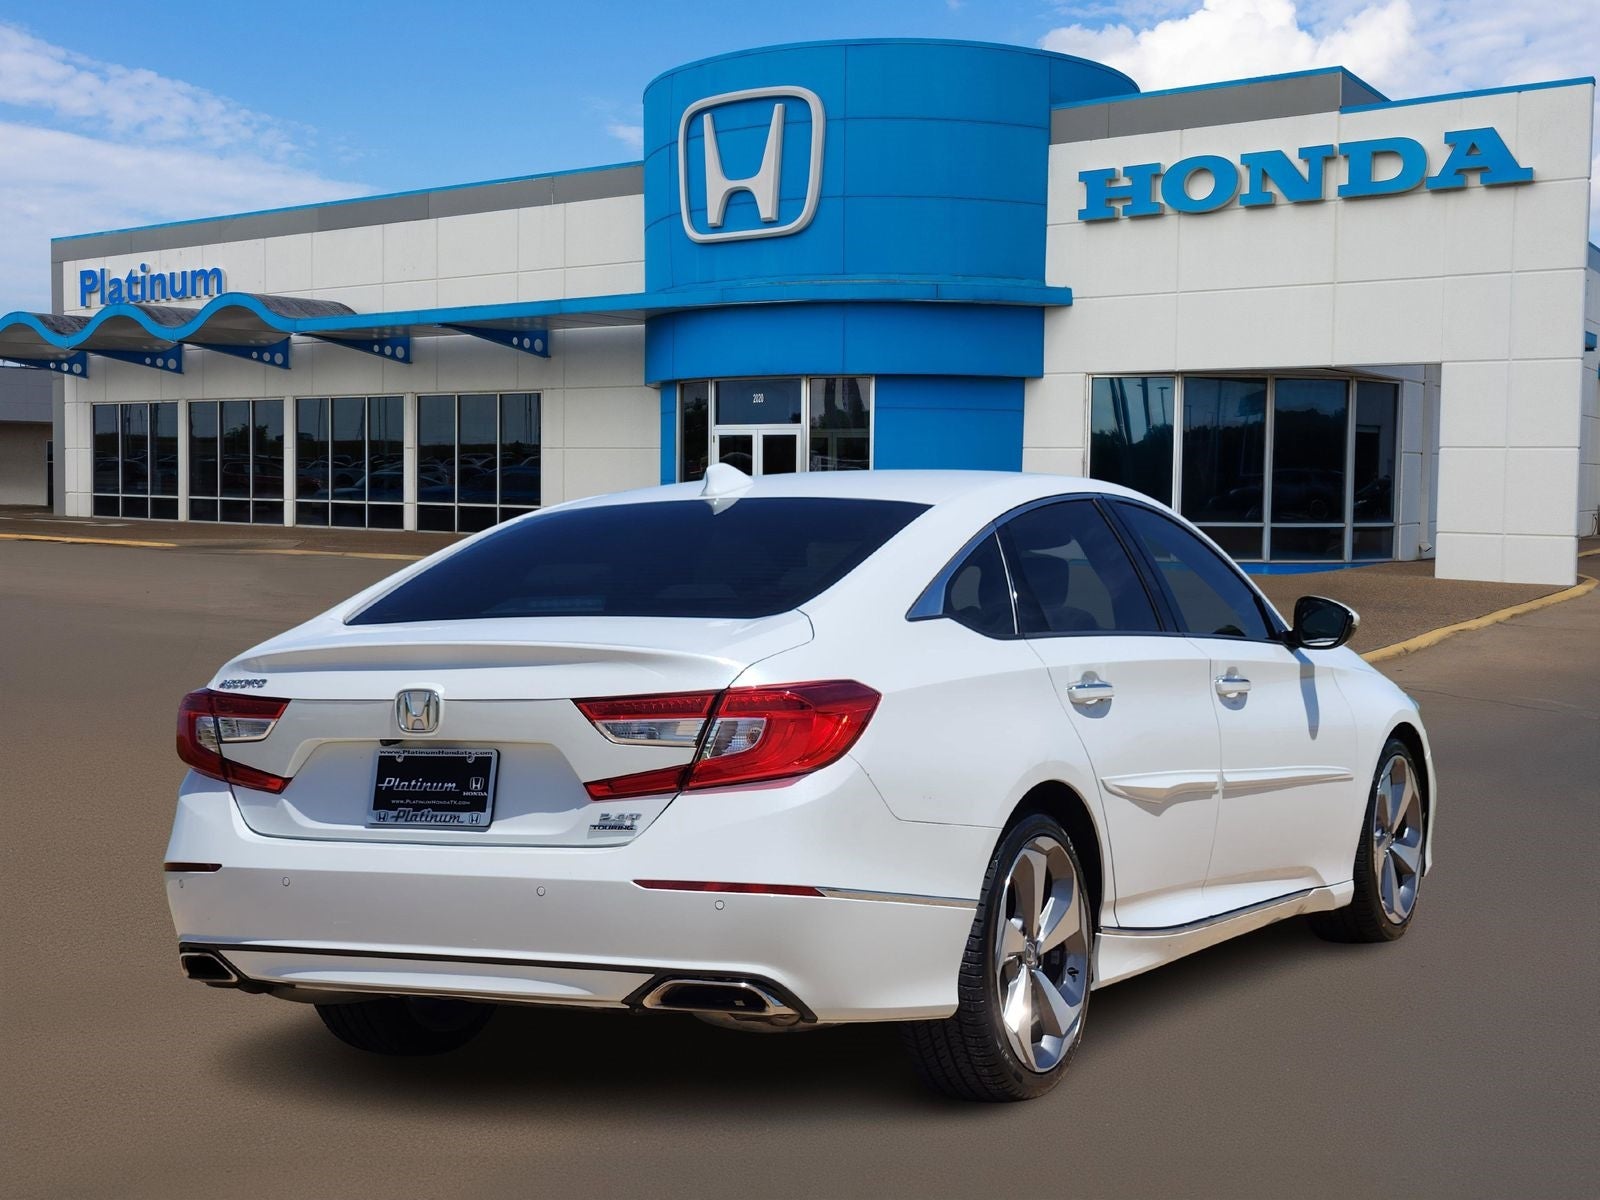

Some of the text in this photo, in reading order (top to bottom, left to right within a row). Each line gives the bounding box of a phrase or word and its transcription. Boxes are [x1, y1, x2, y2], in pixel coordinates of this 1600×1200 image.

[1077, 126, 1535, 222] HONDA
[79, 263, 226, 307] Platinum
[378, 777, 460, 792] Platinum
[390, 808, 464, 824] Platinum
